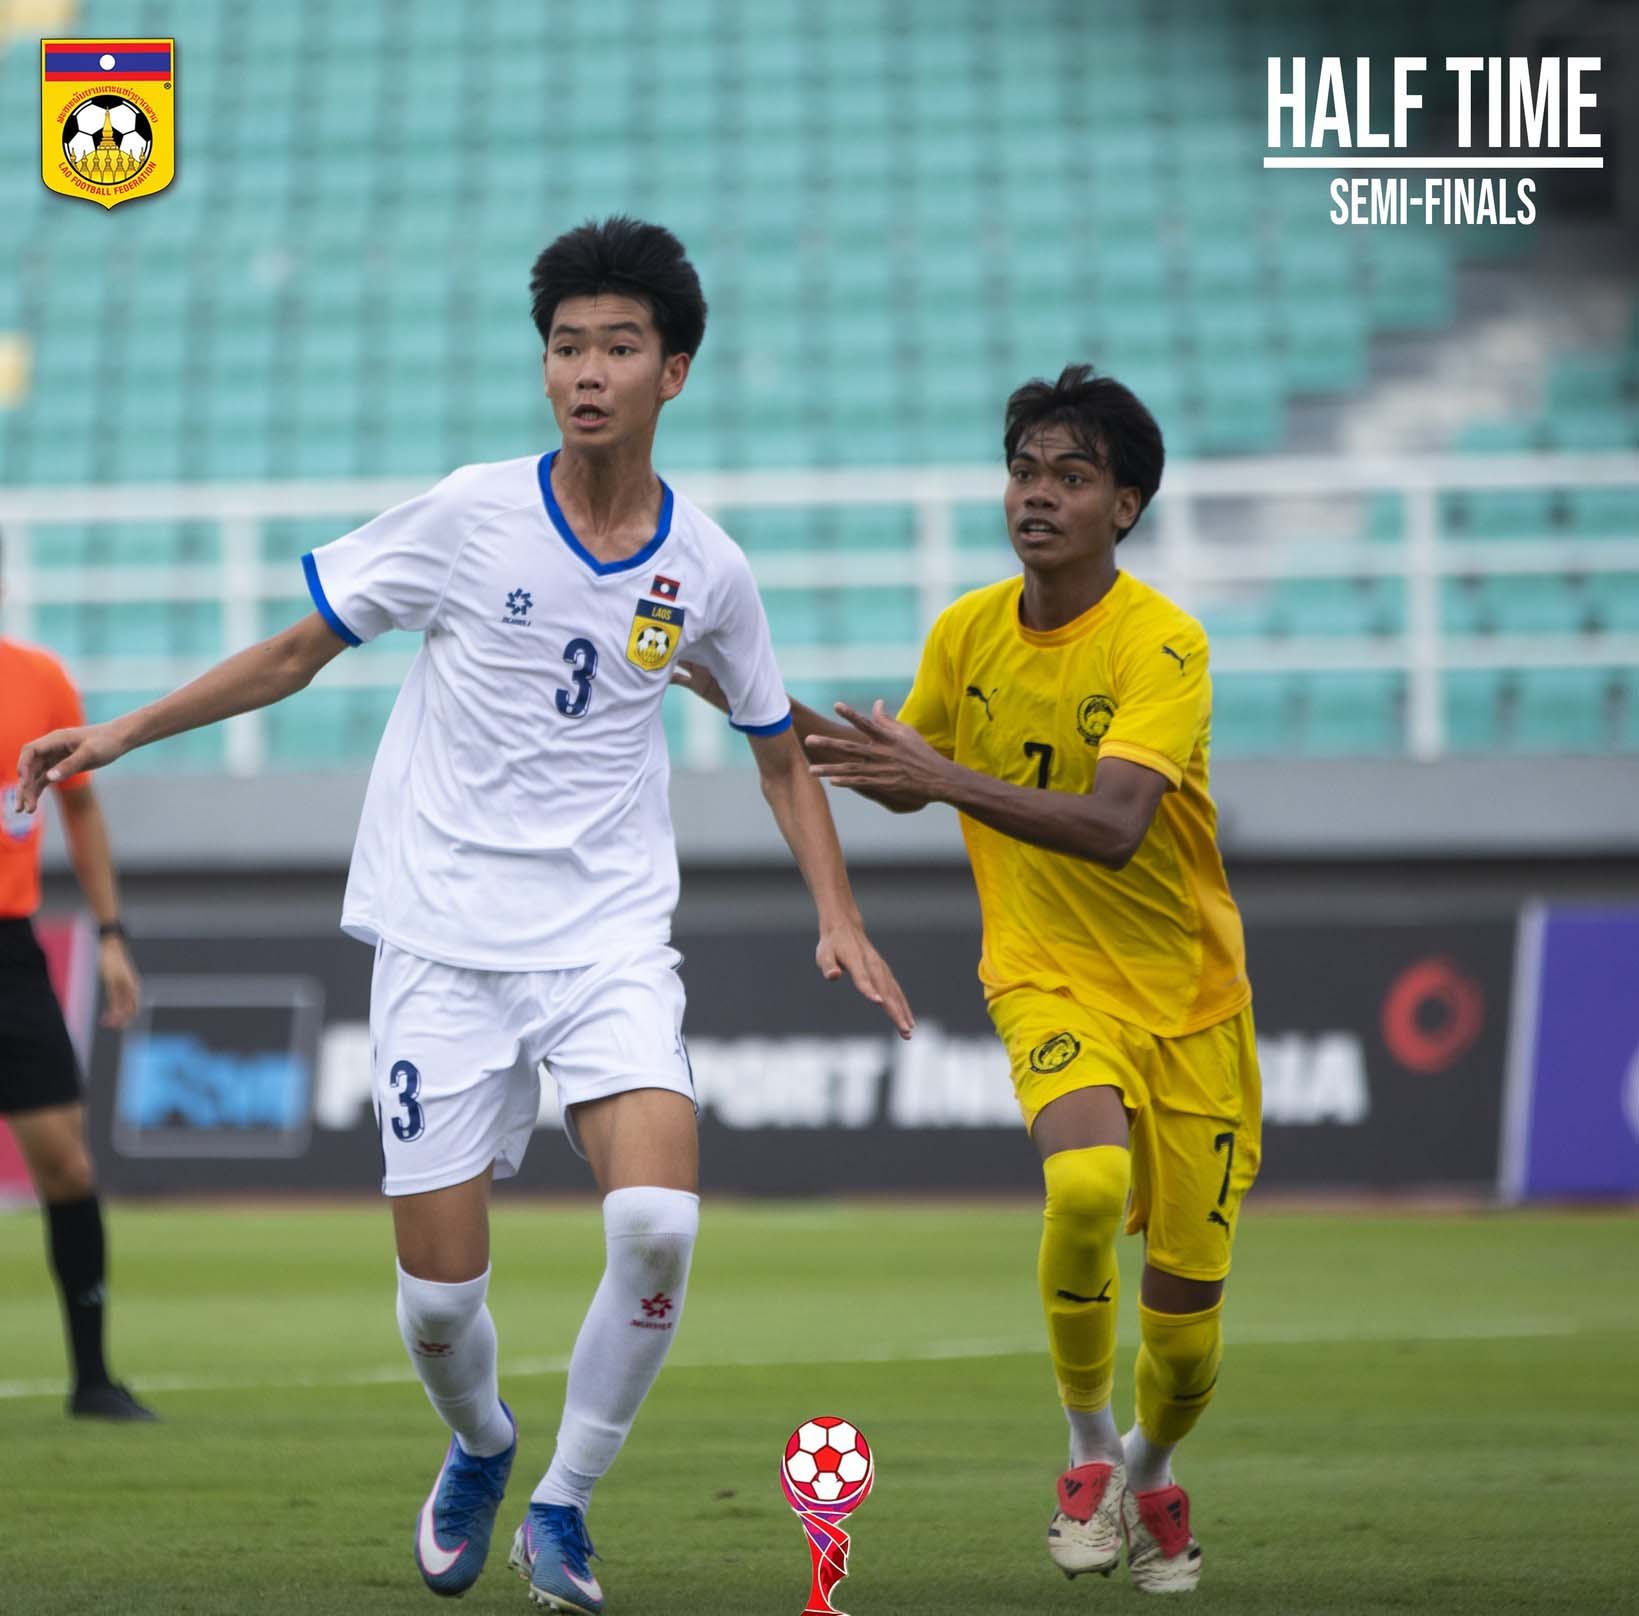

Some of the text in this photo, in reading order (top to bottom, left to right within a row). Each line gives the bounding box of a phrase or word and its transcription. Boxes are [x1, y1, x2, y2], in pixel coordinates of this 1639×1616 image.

[651, 606, 672, 621] LAOS
[555, 637, 599, 719] 3
[1023, 741, 1054, 789] 7
[389, 1059, 426, 1143] 3
[1214, 1132, 1235, 1207] 7
